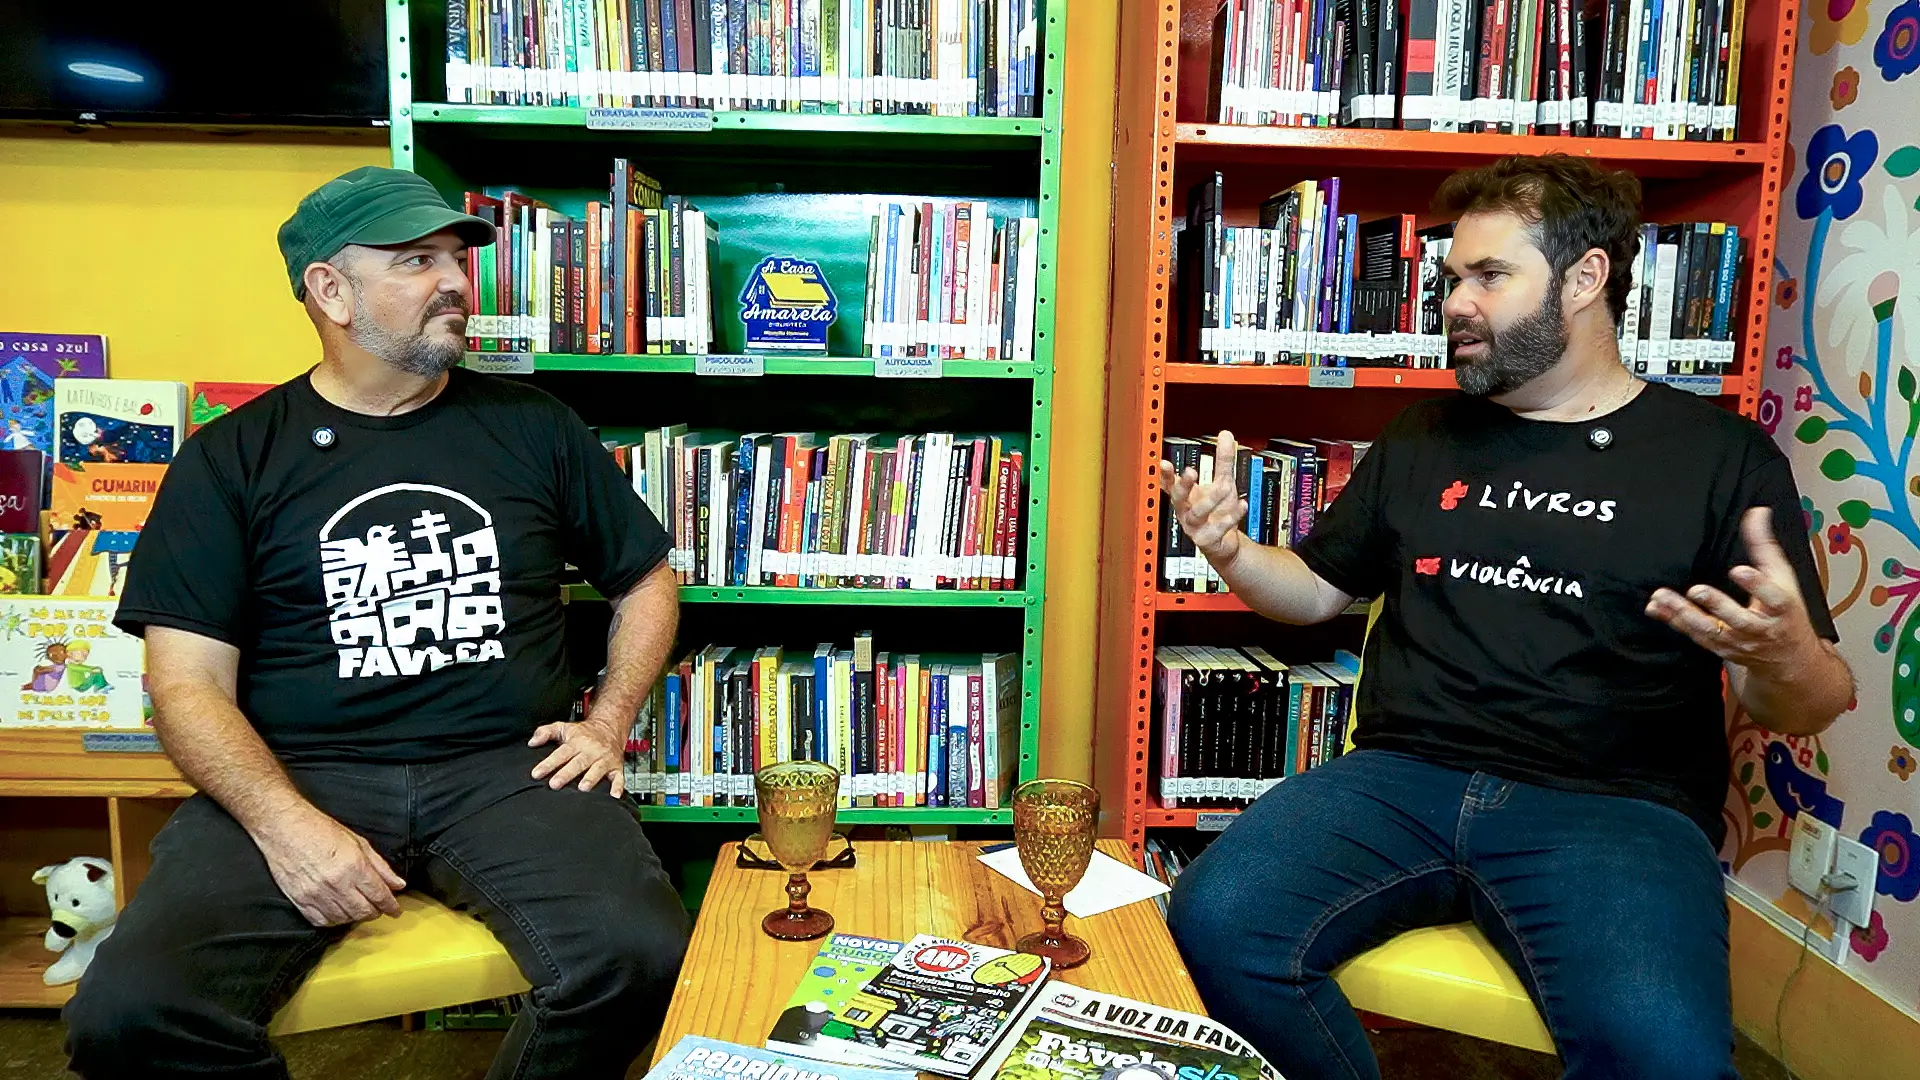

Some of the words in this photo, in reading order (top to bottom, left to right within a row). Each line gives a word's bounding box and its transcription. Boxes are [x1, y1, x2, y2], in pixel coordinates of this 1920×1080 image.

[1446, 35, 1460, 91] HUMANA
[781, 260, 816, 274] Casa
[743, 303, 833, 321] Amarela
[12, 341, 49, 353] casa
[55, 341, 89, 354] azul
[705, 357, 754, 365] PSICOLOGIA
[92, 479, 157, 493] CUMARIM
[1450, 555, 1583, 598] VIOLÊNCIA
[833, 936, 900, 953] NOVOS
[915, 948, 970, 969] ANF
[1081, 1000, 1102, 1018] A
[1104, 1003, 1153, 1029] VOZ
[1154, 1016, 1190, 1038] DA
